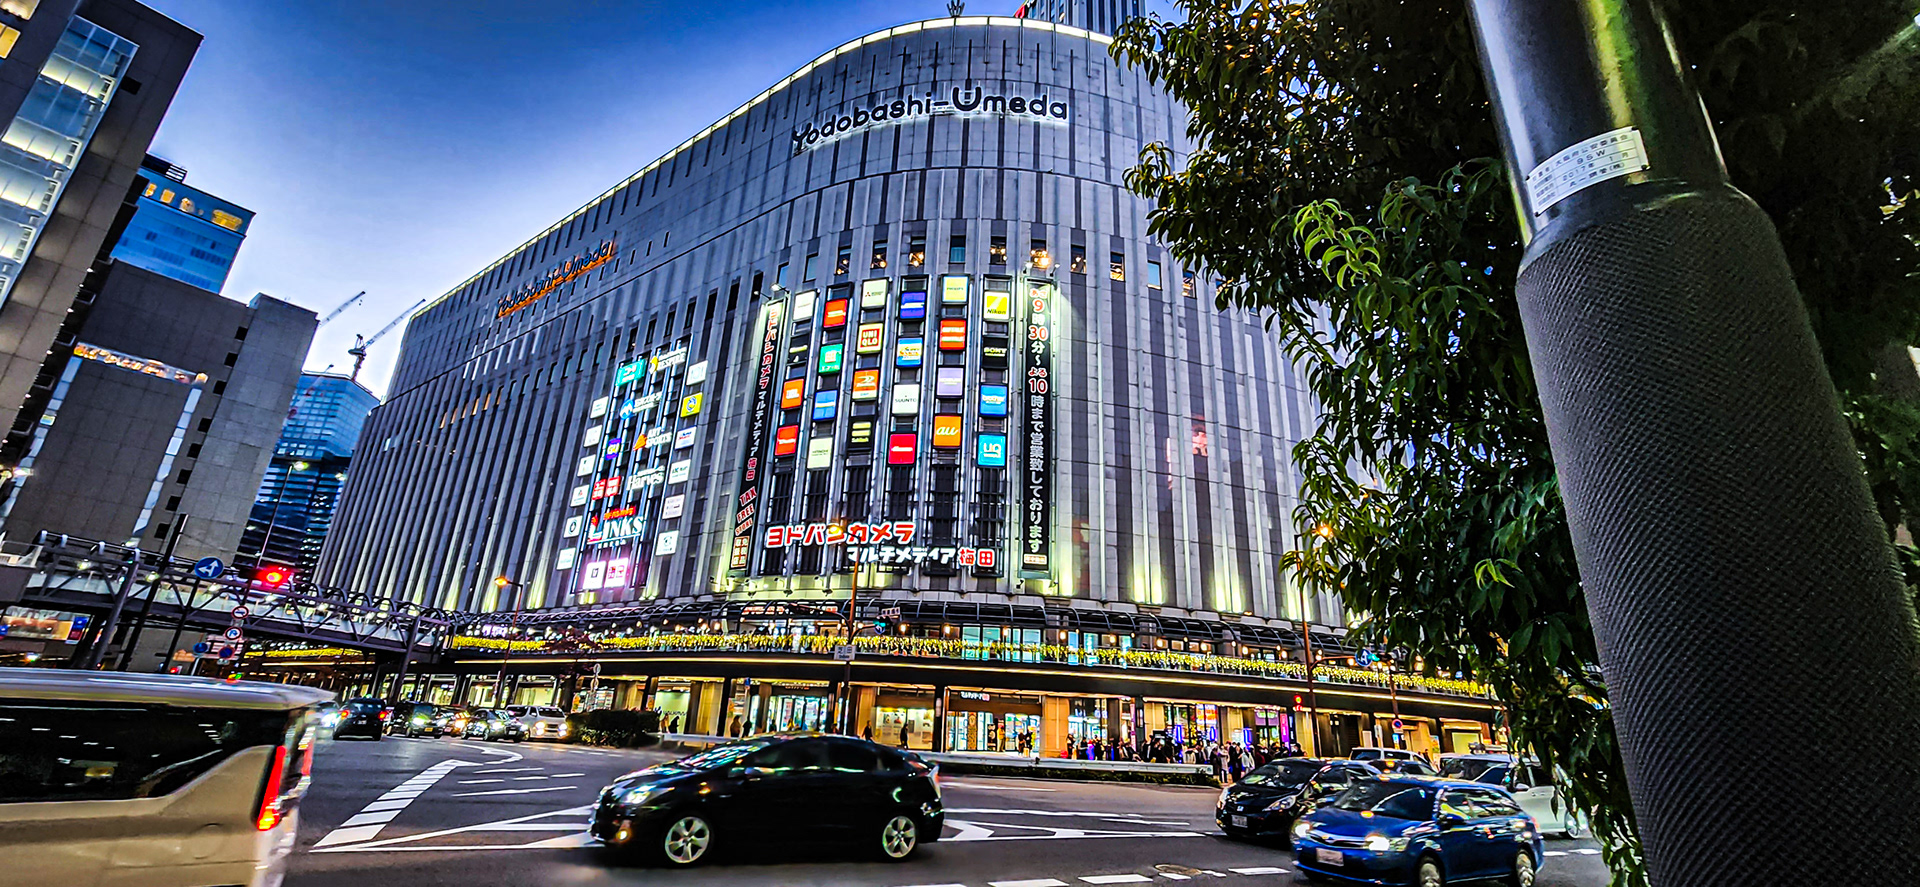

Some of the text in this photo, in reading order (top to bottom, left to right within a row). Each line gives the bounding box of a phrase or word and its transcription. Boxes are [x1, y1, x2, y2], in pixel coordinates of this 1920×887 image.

[793, 87, 1069, 150] Yodobashi-Umeda
[861, 338, 878, 346] QLO
[863, 330, 877, 339] UNI
[936, 426, 958, 435] au
[739, 487, 757, 506] TAX
[736, 504, 754, 523] FREE
[588, 516, 644, 541] LINKS
[846, 547, 996, 568] マルチメディア梅田
